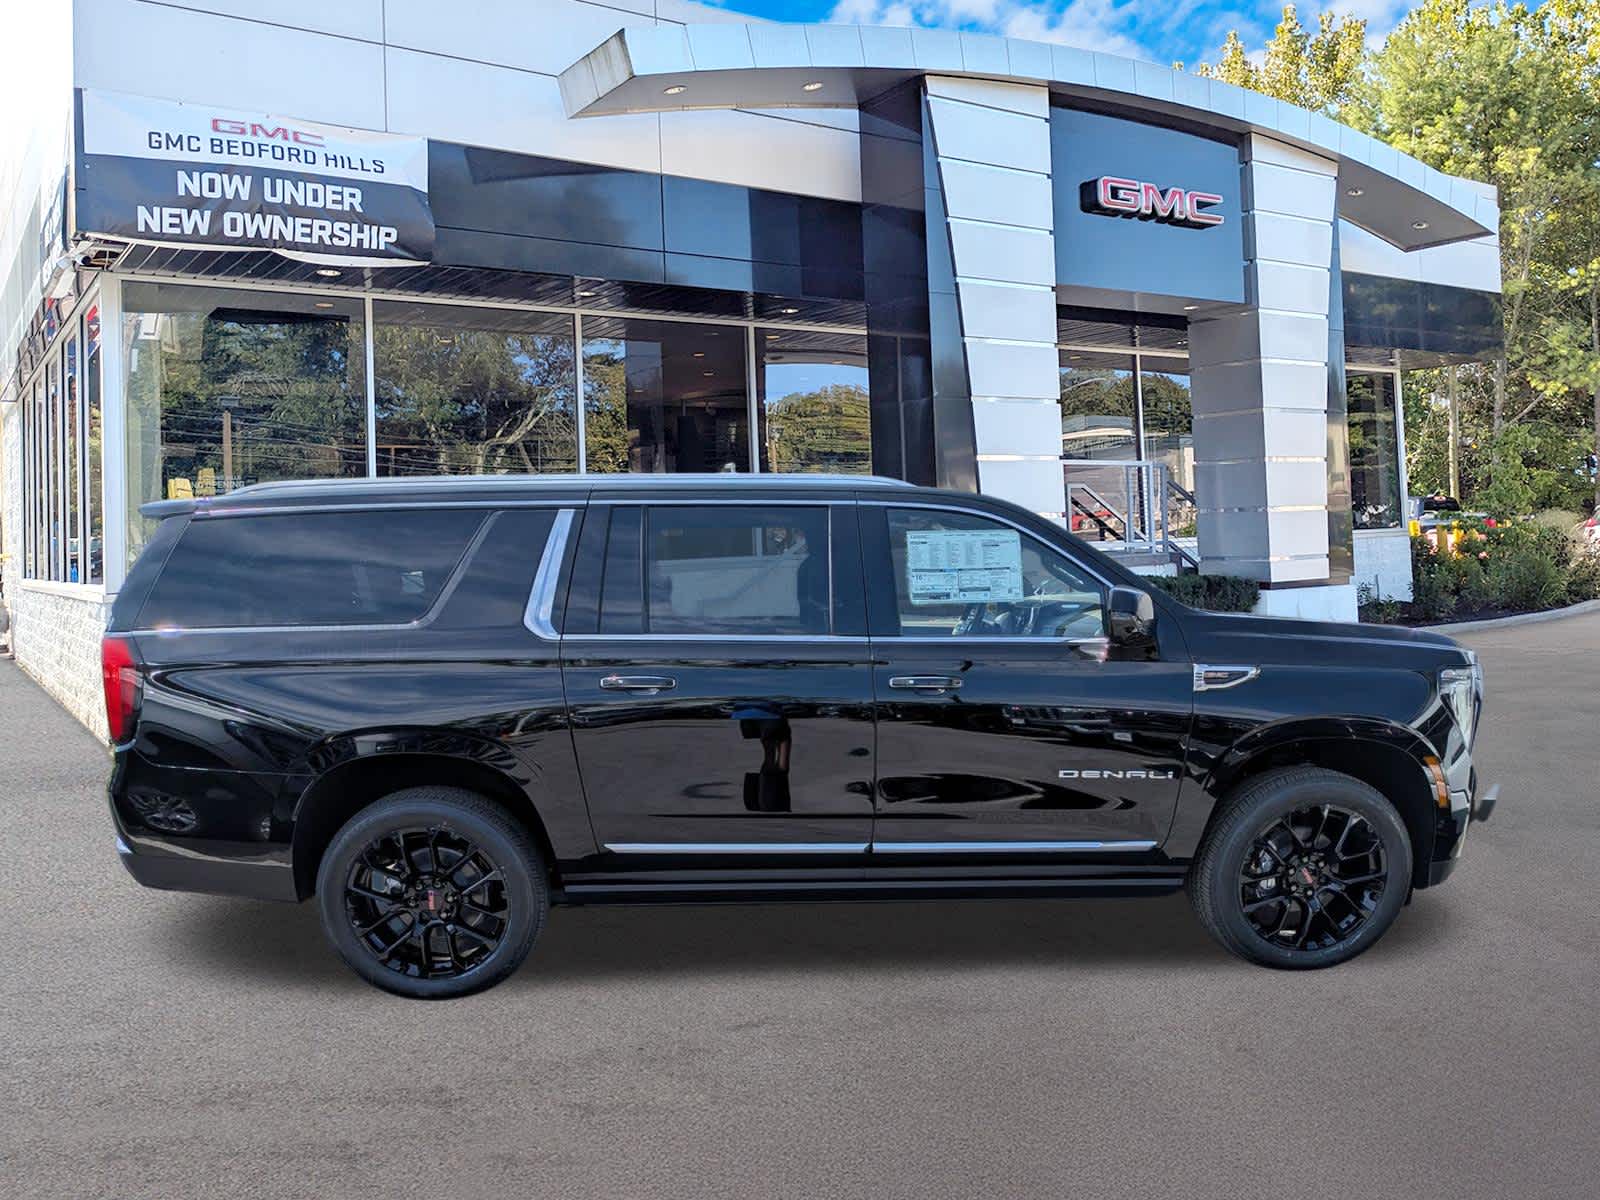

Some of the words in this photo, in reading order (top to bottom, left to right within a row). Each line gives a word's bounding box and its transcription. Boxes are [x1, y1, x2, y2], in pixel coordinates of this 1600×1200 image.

[148, 131, 201, 153] GMC
[210, 138, 317, 166] BEDFORD
[325, 153, 385, 175] HILLS
[211, 117, 326, 148] GMC
[177, 170, 252, 202] NOW
[263, 177, 364, 213] UNDER
[1096, 175, 1225, 225] GMC
[137, 205, 211, 236] NEW
[223, 211, 398, 251] OWNERSHIP
[1058, 769, 1174, 780] DENALI
